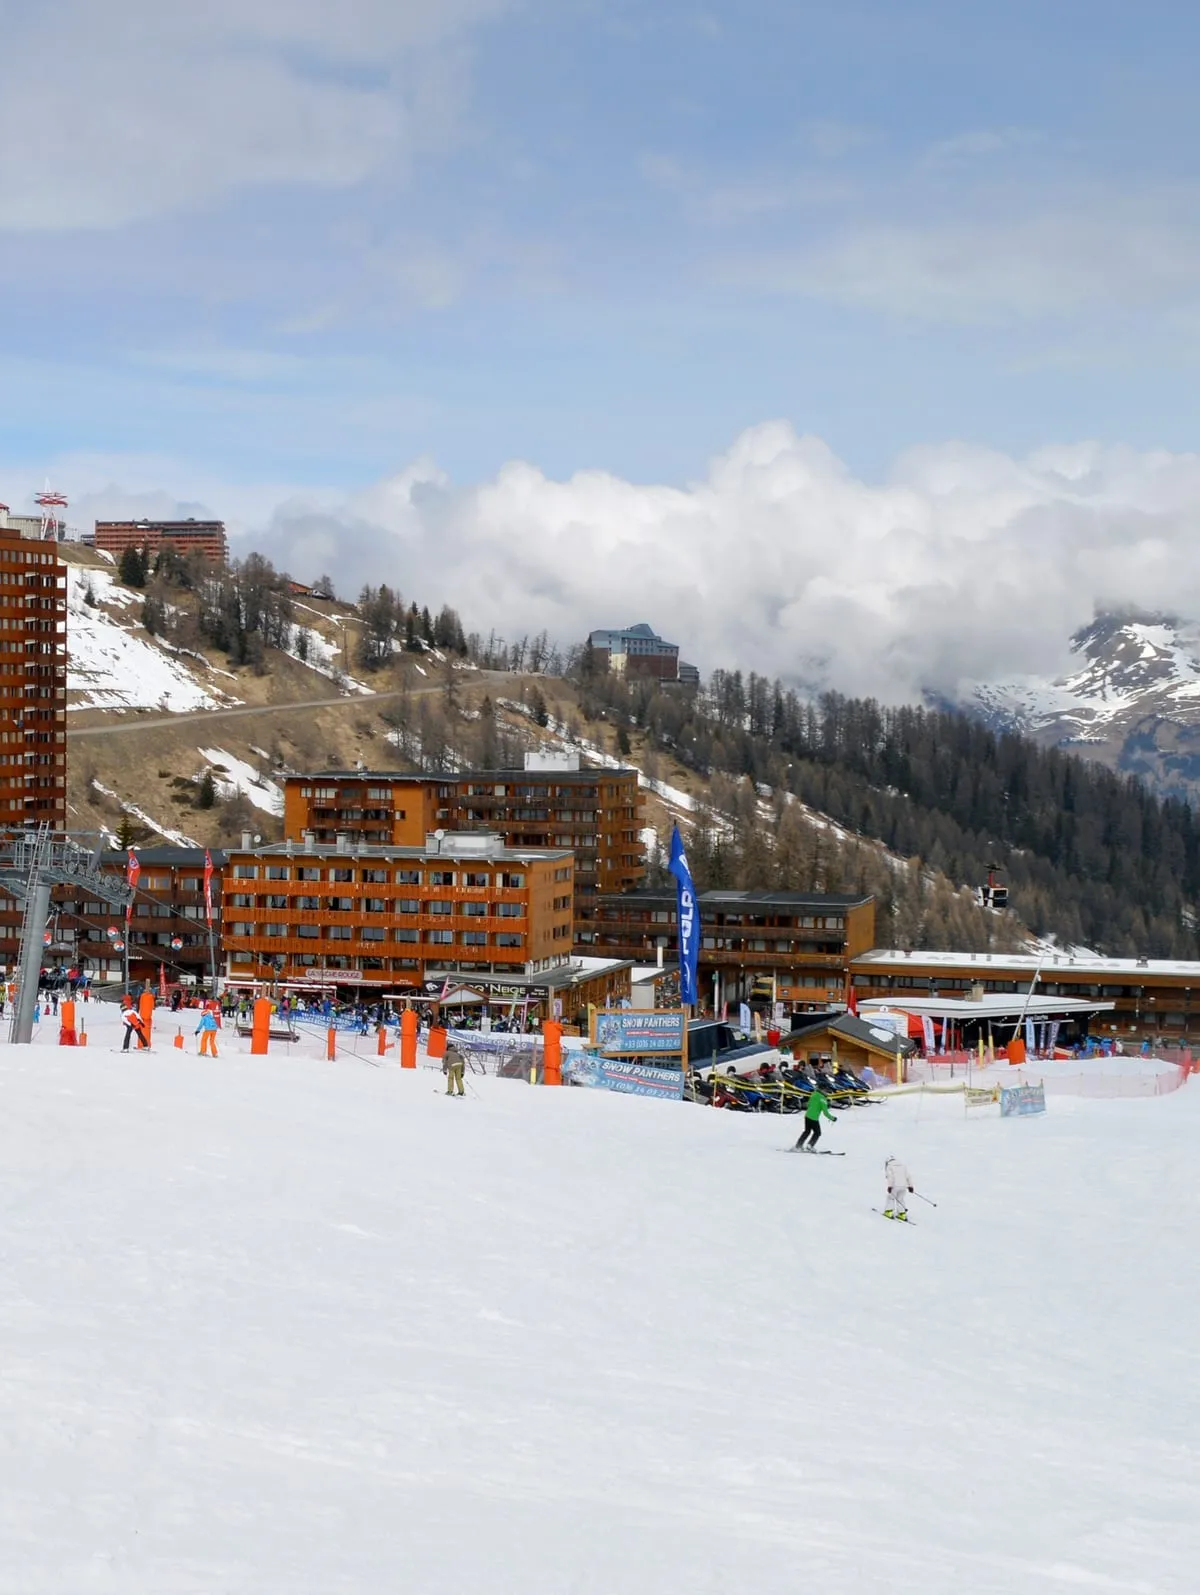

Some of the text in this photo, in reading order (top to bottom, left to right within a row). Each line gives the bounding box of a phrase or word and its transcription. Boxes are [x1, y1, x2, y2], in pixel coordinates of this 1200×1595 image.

[622, 1017, 680, 1028] SNOW PANTHERS
[602, 1062, 633, 1074] SNOW
[632, 1067, 680, 1082] PANTHERS
